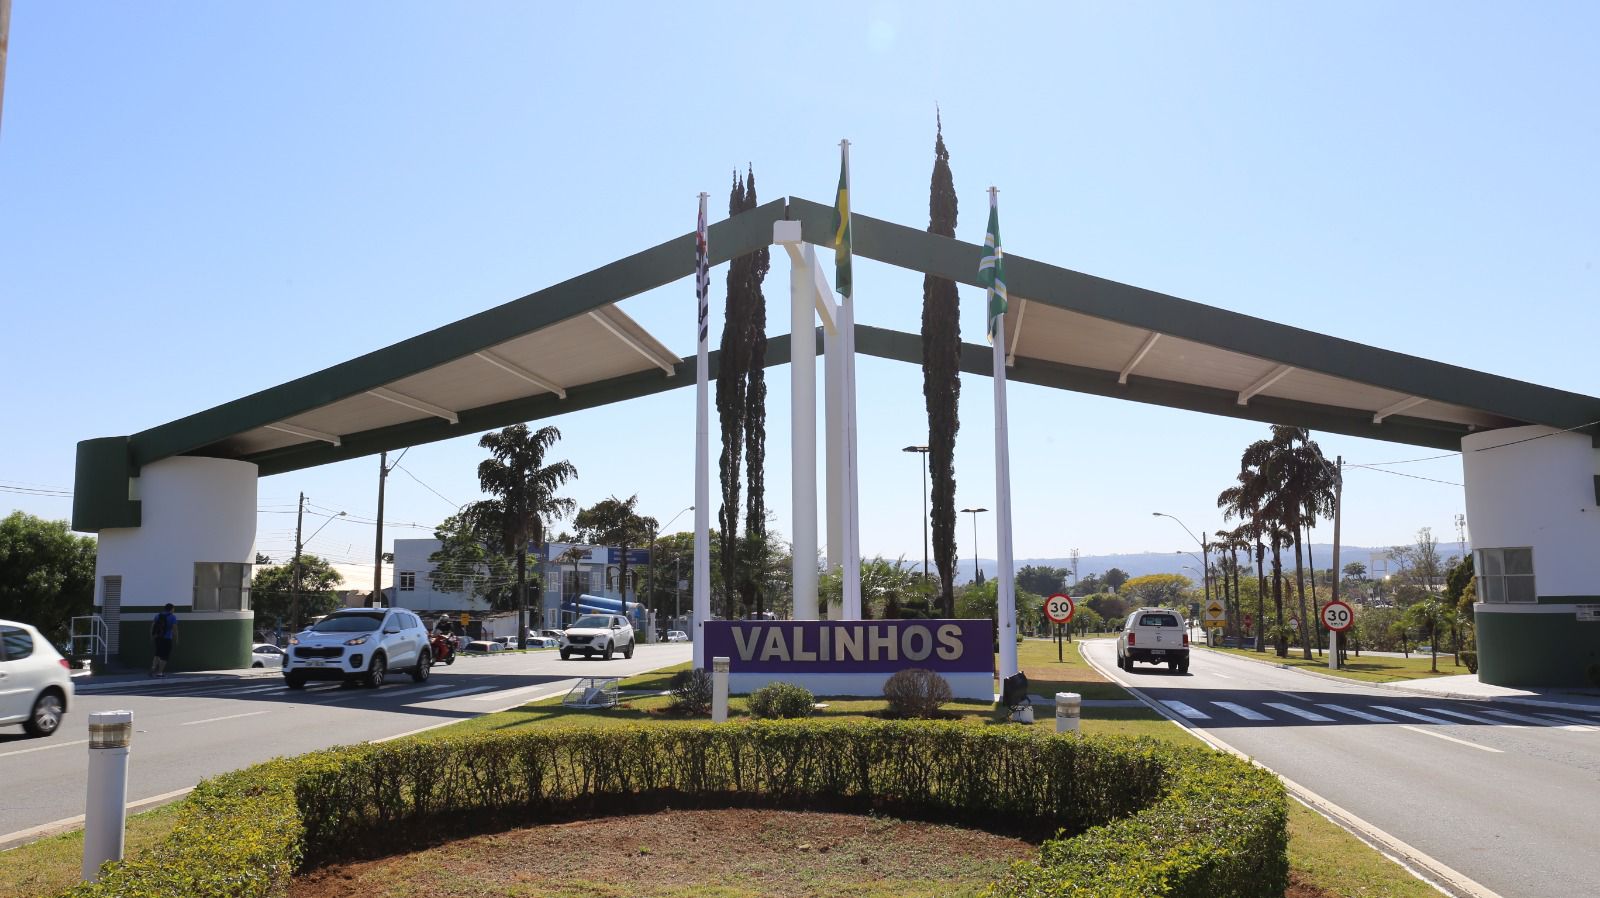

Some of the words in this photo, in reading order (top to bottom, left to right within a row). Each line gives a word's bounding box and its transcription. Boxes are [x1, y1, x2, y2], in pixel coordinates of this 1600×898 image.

[1050, 601, 1069, 613] 30
[1327, 610, 1348, 621] 30
[731, 624, 964, 662] VALINHOS
